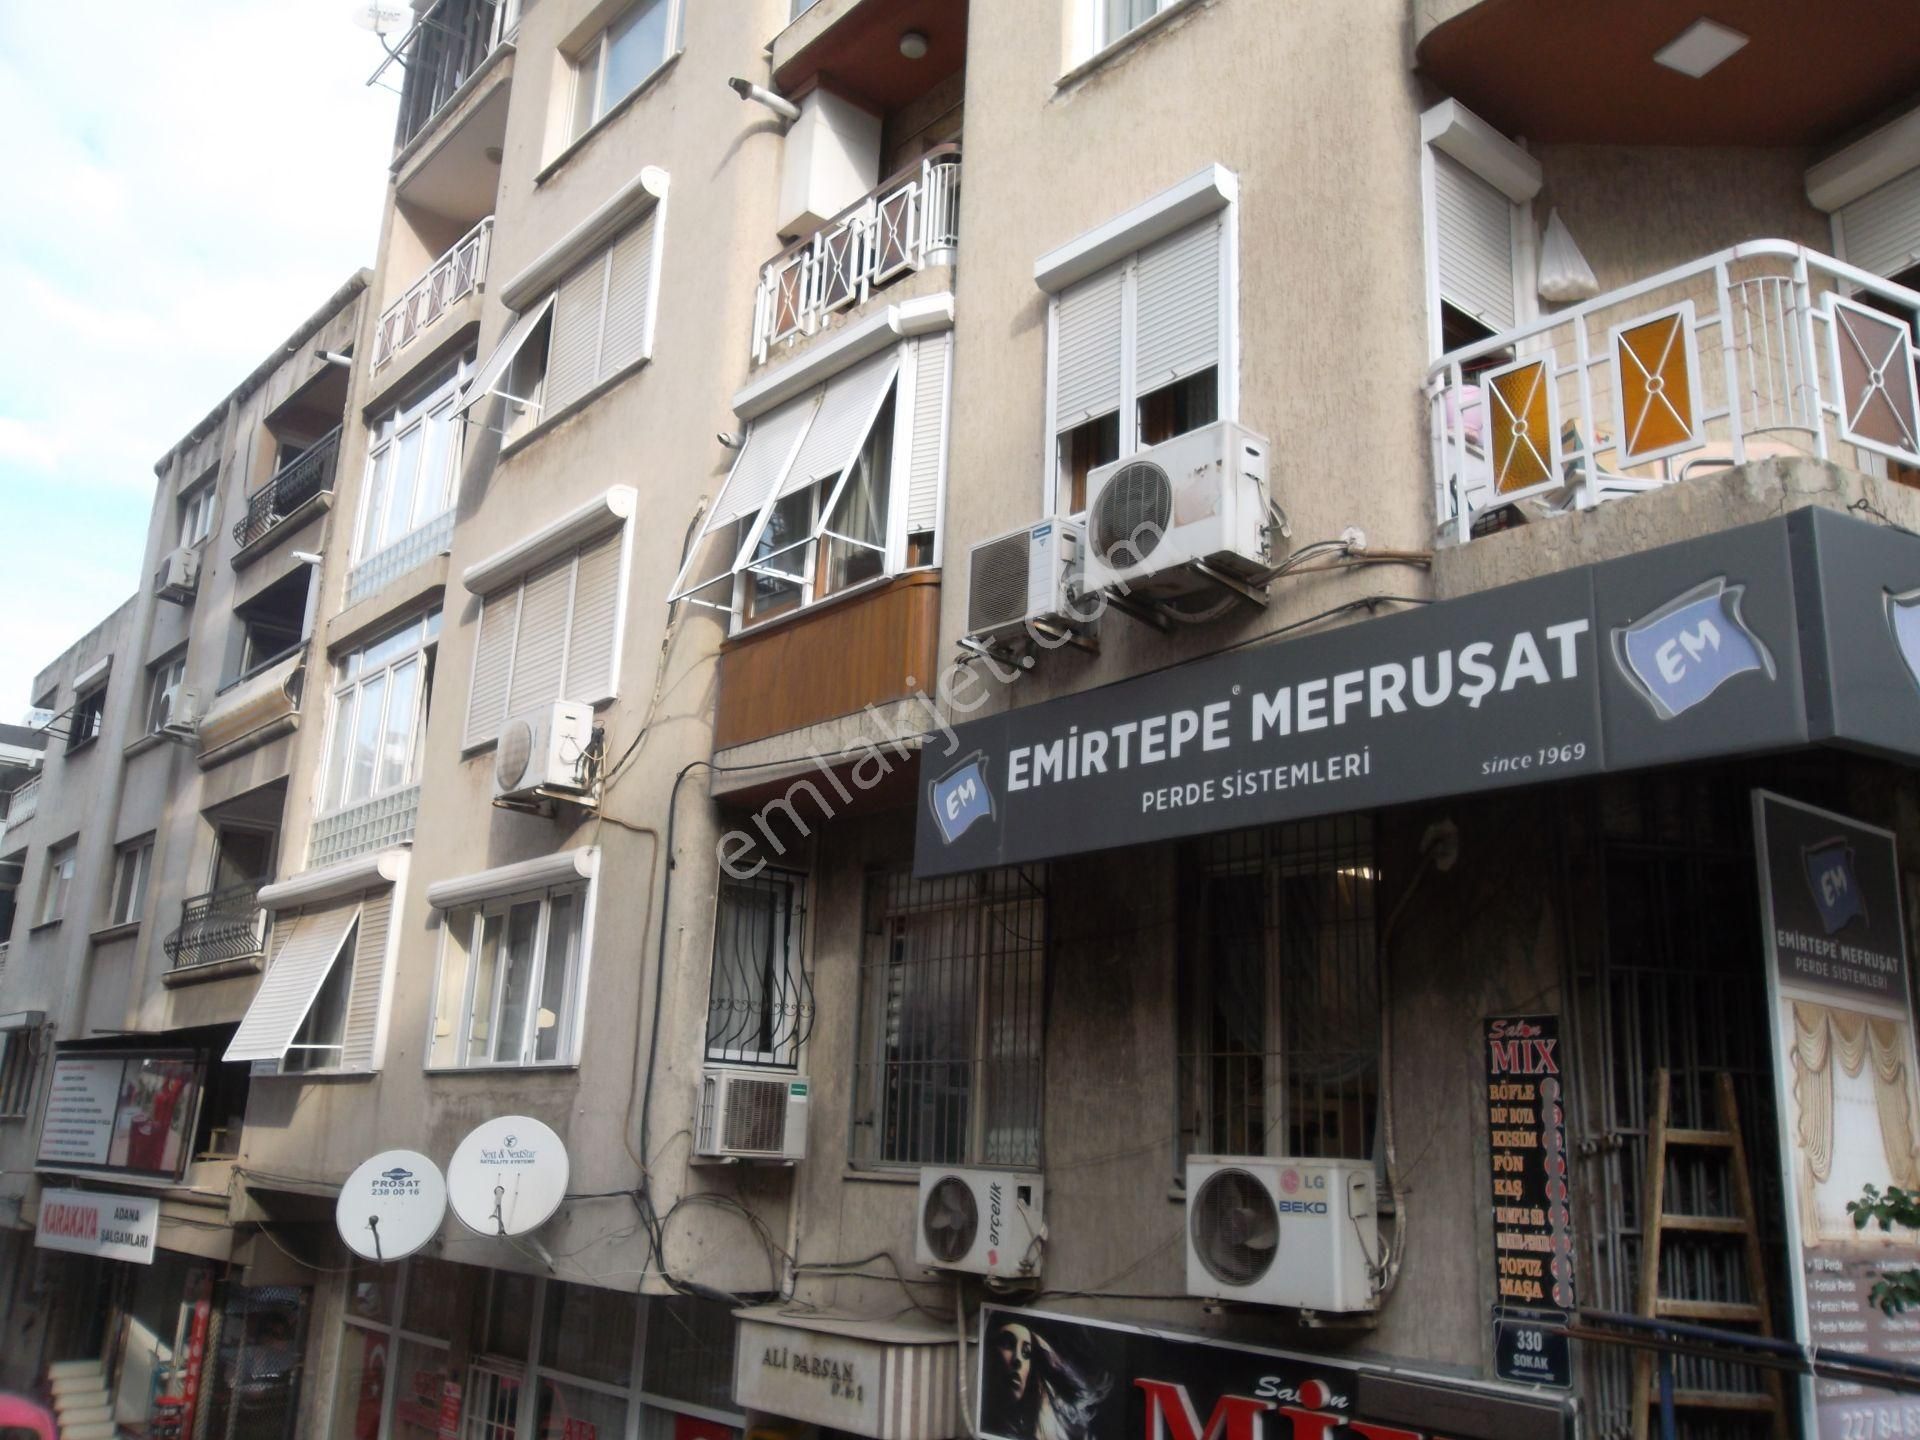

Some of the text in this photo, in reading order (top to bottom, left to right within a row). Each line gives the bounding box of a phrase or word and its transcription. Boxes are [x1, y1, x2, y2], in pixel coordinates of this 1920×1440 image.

[1655, 618, 1721, 685] EM
[1007, 618, 1590, 792] EMİRTEPE MEFRUŞAT
[1482, 742, 1586, 775] since 1969
[1142, 745, 1371, 813] PERDE SİSTEMLERİ
[946, 778, 977, 820] EM
[1821, 865, 1848, 907] EM
[1777, 929, 1899, 974] EMİRTEPE MEFRUŞAT
[1795, 957, 1888, 990] PERDE SİSTEMLERİ
[1489, 1038, 1560, 1075] MIX
[1492, 1126, 1538, 1147] KESİM
[1493, 1150, 1524, 1172] FÖN
[371, 1180, 421, 1188] PROSAT
[371, 1188, 420, 1196] 238 00 16
[1304, 1175, 1325, 1189] LG
[1494, 1179, 1523, 1202] KAŞ
[114, 1207, 140, 1222] ADANA
[989, 1182, 1002, 1246] arçelik
[1279, 1200, 1328, 1214] BEKO
[42, 1203, 98, 1241] KARAKAYA
[1498, 1256, 1542, 1278] TOPUZ
[1500, 1278, 1544, 1302] MAŞA
[1517, 1330, 1543, 1352] 330
[1513, 1354, 1549, 1370] SOKAK
